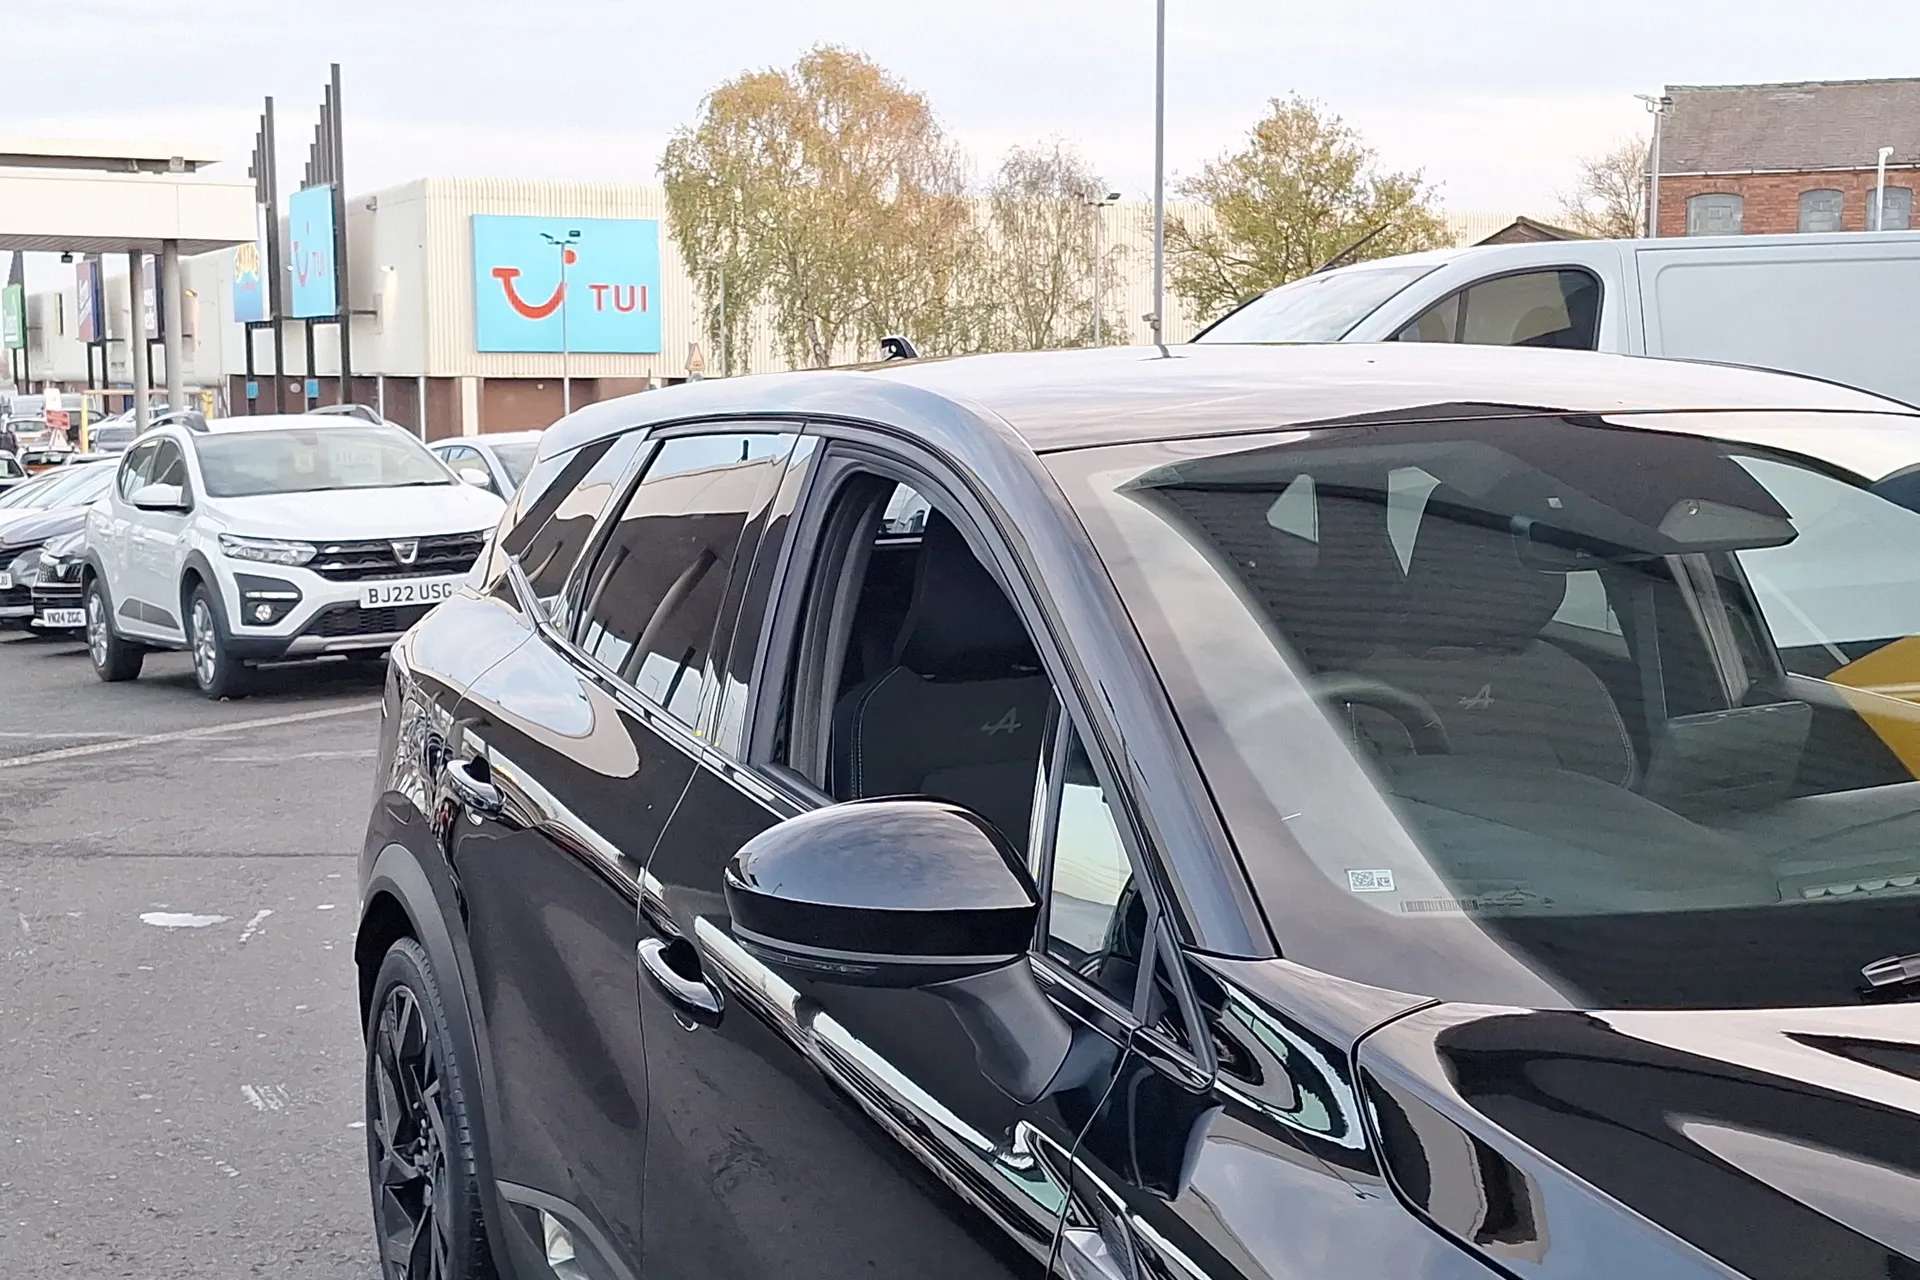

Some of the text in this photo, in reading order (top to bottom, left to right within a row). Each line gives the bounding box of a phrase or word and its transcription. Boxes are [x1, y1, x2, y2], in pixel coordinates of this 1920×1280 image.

[589, 284, 647, 313] TUI
[368, 583, 453, 604] BJ22 USG
